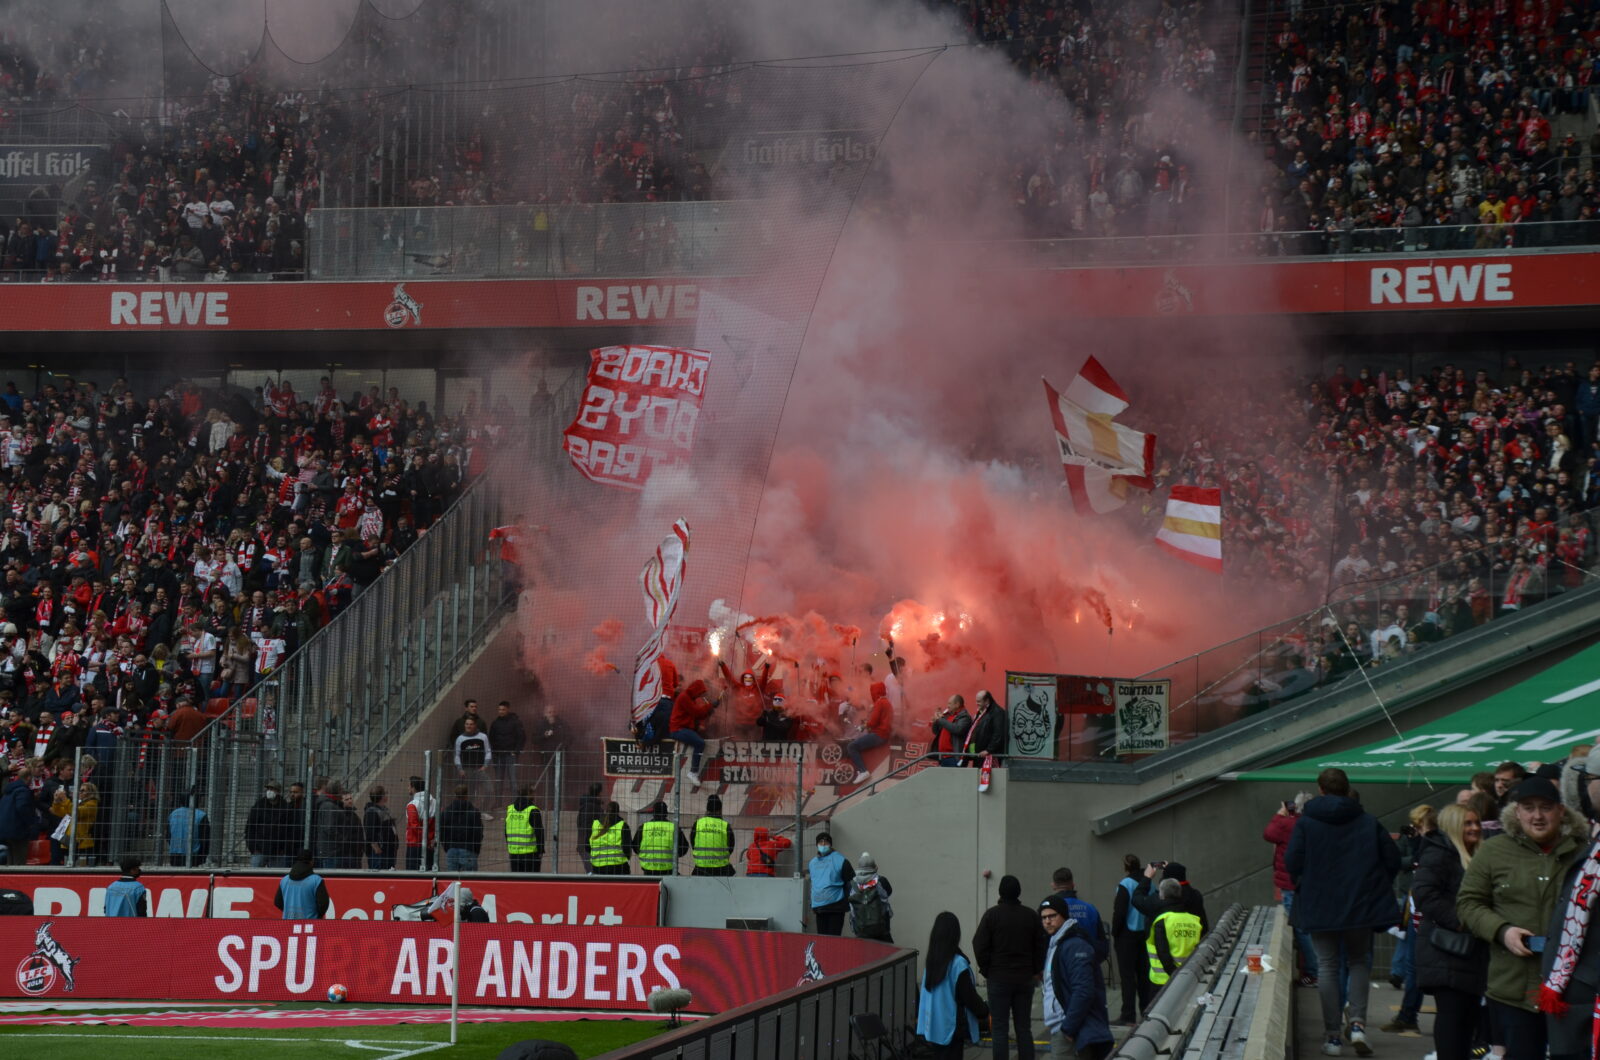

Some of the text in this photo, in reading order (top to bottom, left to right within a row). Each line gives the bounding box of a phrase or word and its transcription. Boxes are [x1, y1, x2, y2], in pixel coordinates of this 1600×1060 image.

[1370, 263, 1514, 304] REWE
[110, 291, 229, 326] REWE
[576, 284, 698, 322] REWE
[609, 755, 669, 766] PARADISO
[722, 741, 818, 764] SEKTION
[474, 938, 684, 1003] ANDERS
